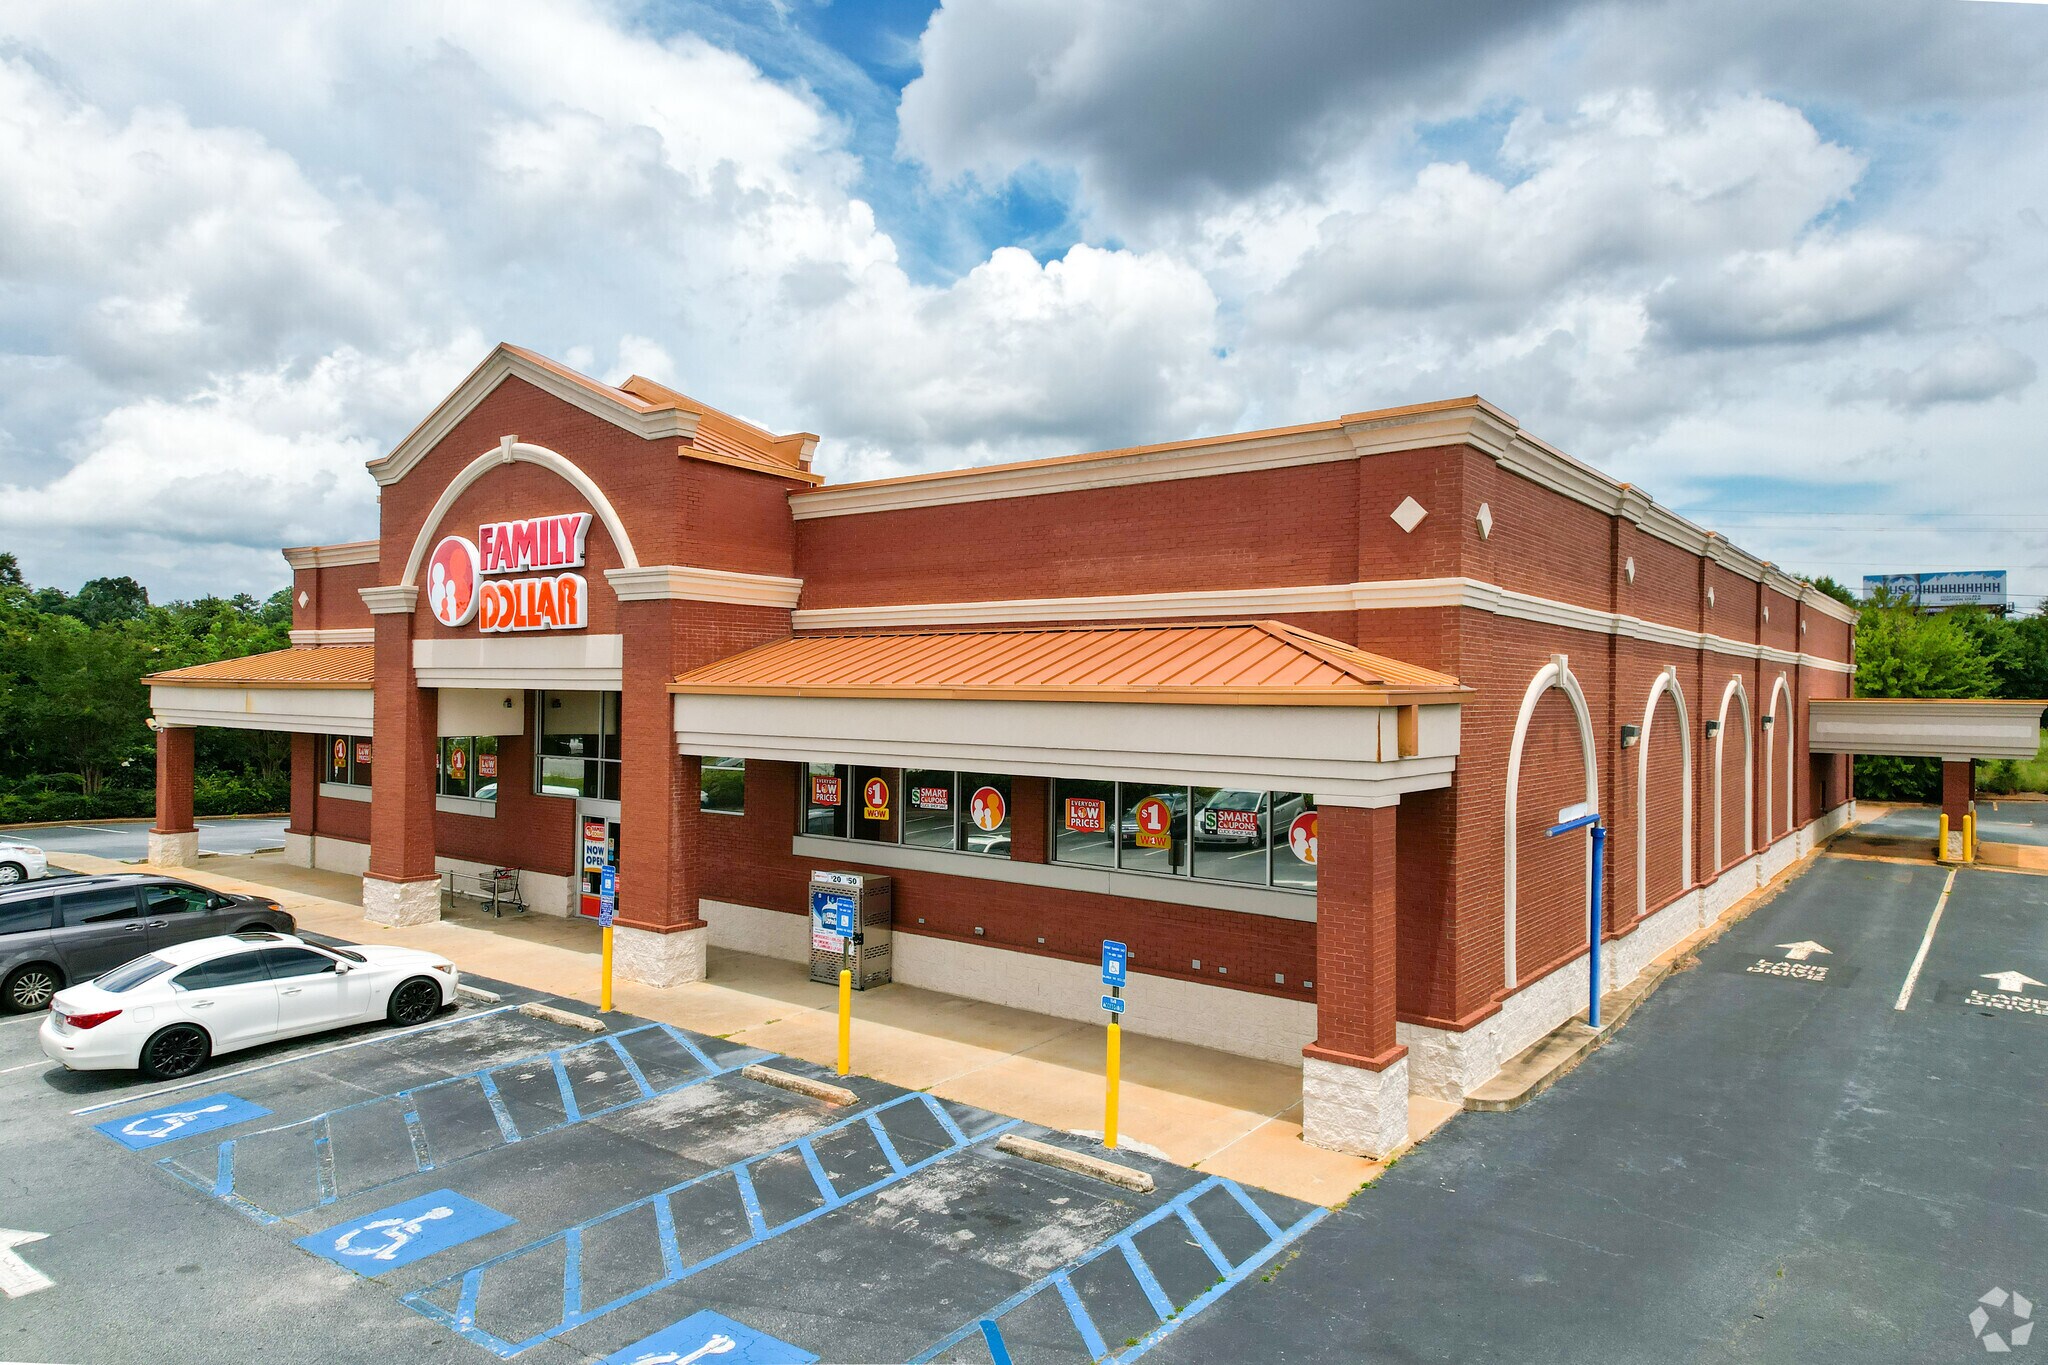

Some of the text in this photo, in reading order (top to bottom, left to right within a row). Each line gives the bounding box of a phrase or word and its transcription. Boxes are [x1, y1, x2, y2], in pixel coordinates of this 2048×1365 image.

[480, 515, 582, 571] FAMILY
[480, 577, 578, 629] DOLLAR
[816, 783, 837, 794] LOW
[867, 782, 882, 805] $1
[921, 788, 947, 798] SMART
[816, 793, 837, 802] PRICES
[921, 796, 947, 804] COUPONS
[1071, 800, 1099, 808] EVERYDAY
[1071, 806, 1099, 819] LOW
[1141, 804, 1162, 830] $1
[1218, 811, 1256, 823] SMART
[1071, 818, 1099, 828] PRICES
[1218, 821, 1256, 831] COUPONS
[586, 845, 604, 856] NOW
[586, 855, 604, 866] OPEN
